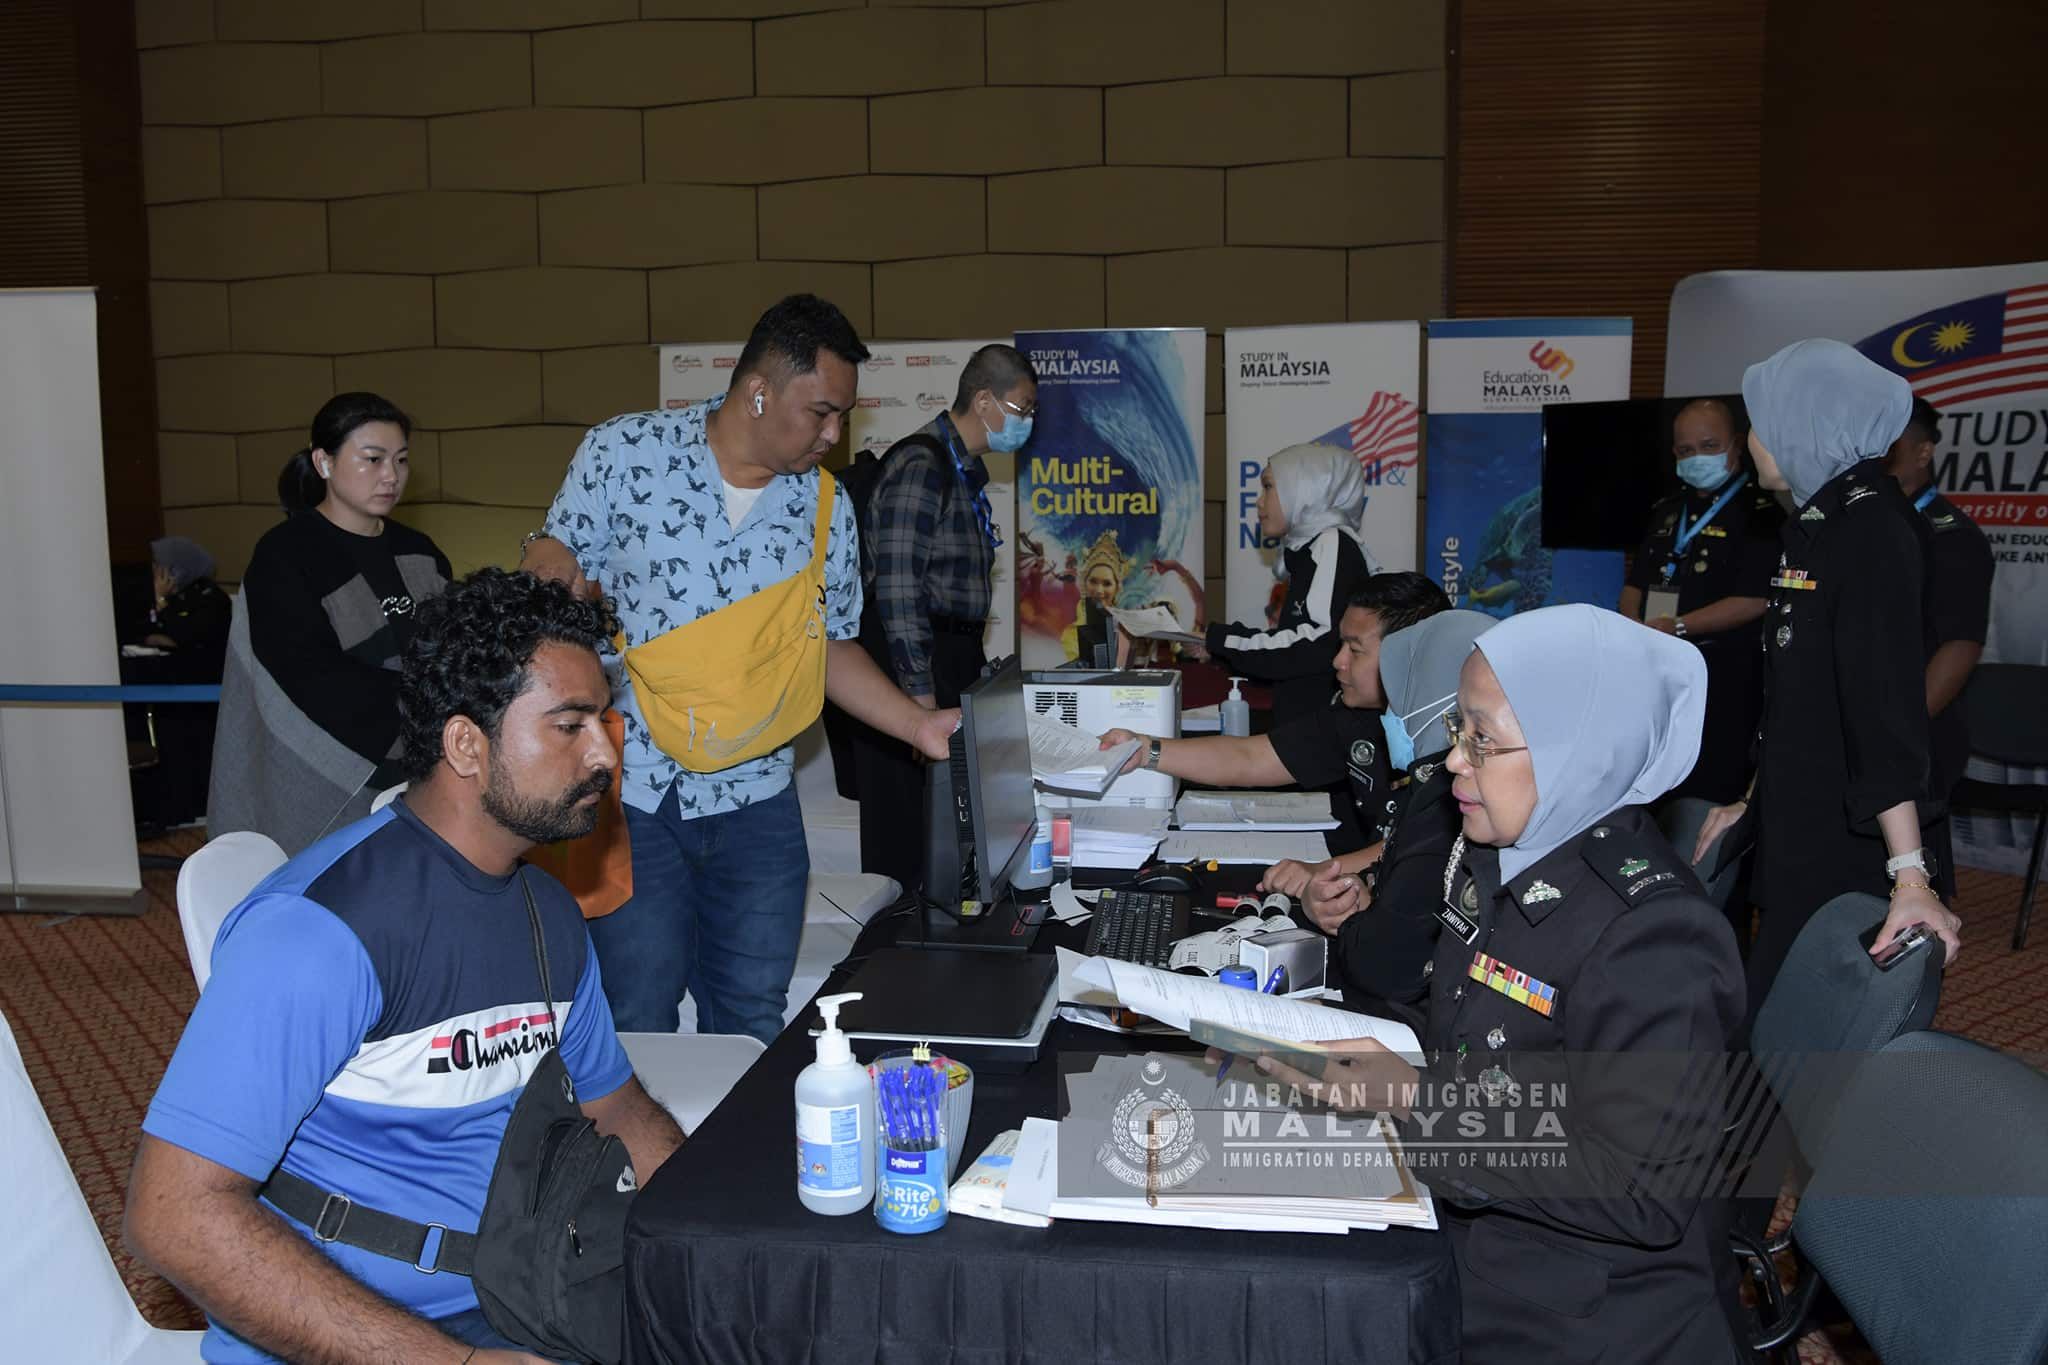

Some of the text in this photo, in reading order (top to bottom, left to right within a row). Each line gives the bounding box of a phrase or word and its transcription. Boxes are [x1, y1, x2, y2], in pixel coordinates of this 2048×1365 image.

[1030, 350, 1079, 360] STUDY IN
[1240, 352, 1288, 362] STUDY IN
[1031, 360, 1120, 375] MALAYSIA
[1240, 361, 1330, 378] MALAYSIA
[1483, 369, 1549, 384] Education
[1483, 385, 1570, 396] MALAYSIA
[1031, 456, 1123, 485] Multi-
[1386, 463, 1406, 486] &
[1031, 487, 1157, 515] Cultural
[1957, 501, 2027, 523] ersity
[901, 1203, 929, 1217] 716
